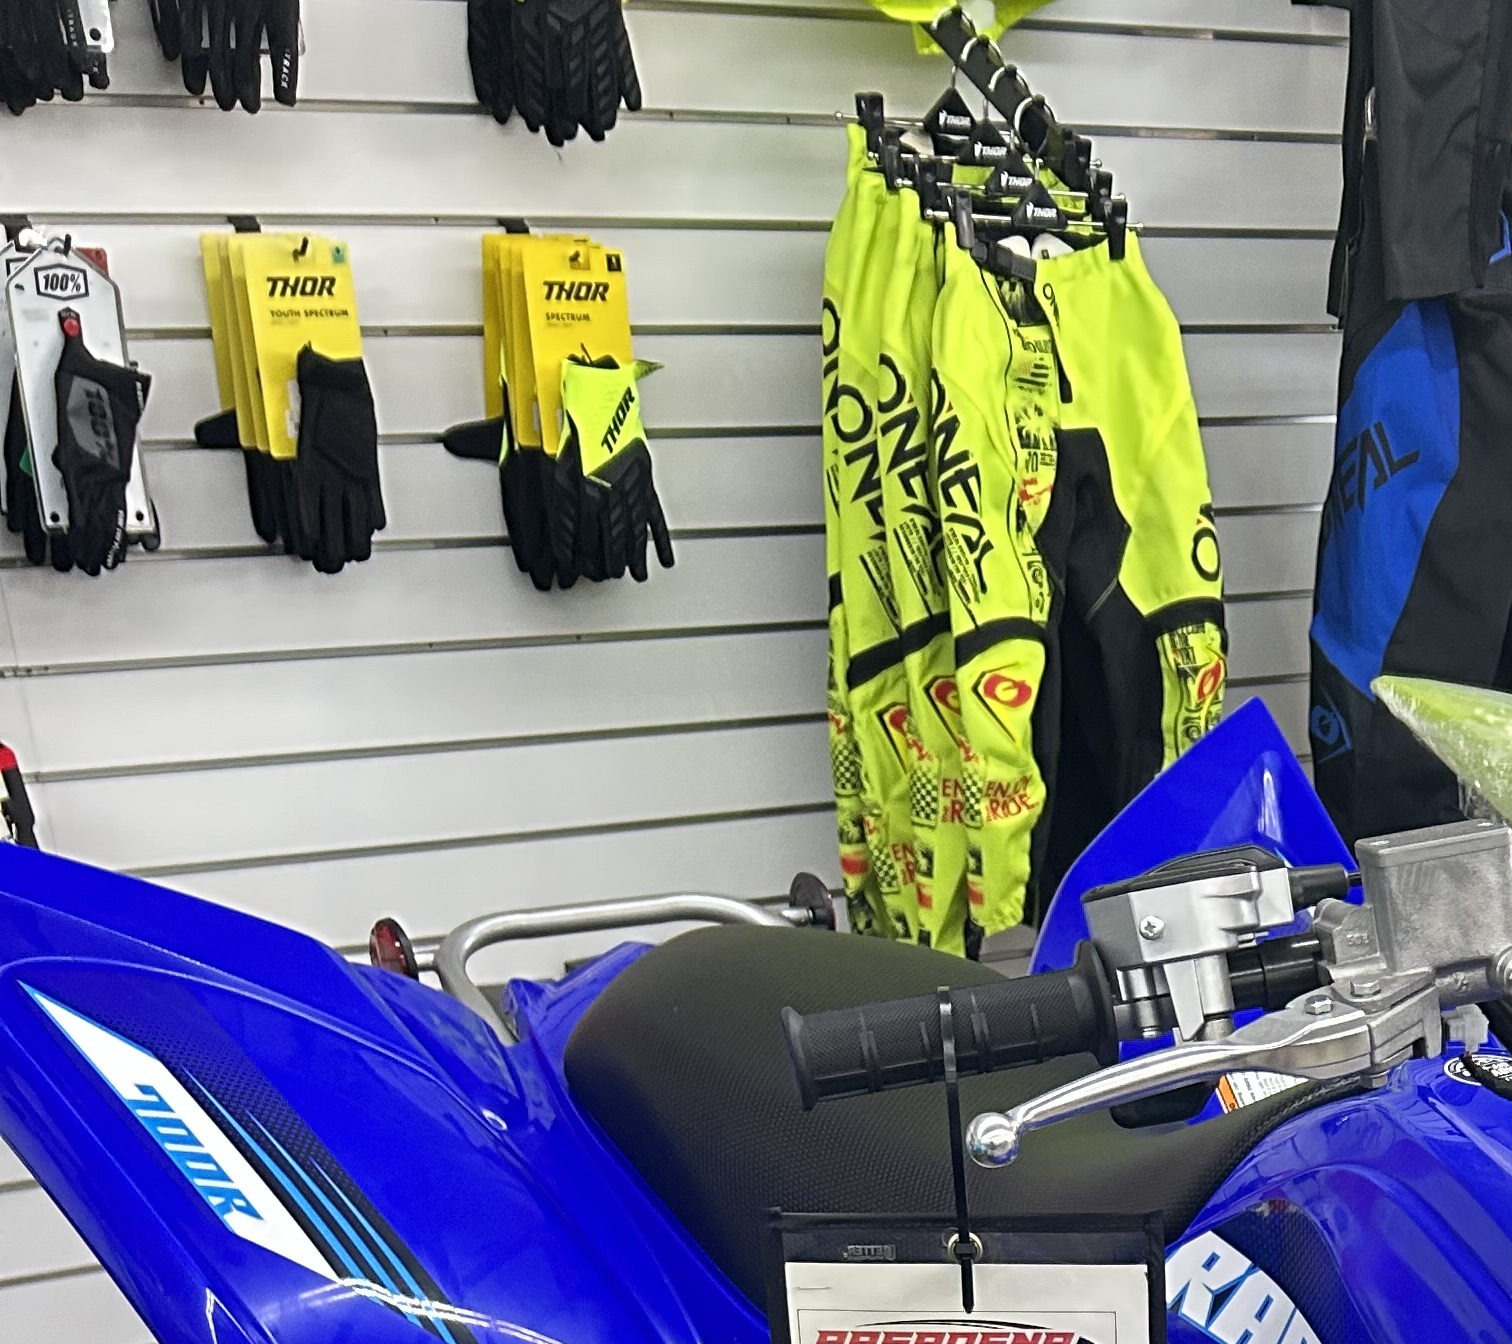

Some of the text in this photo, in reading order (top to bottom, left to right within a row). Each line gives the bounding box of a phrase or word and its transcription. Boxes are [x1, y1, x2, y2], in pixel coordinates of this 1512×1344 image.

[43, 273, 81, 292] 100%
[266, 275, 336, 297] THOR
[543, 280, 610, 302] THOR
[270, 309, 349, 318] YOUTH SPECTRUM
[545, 312, 591, 322] SPECTRUM
[600, 386, 636, 454] THOR
[125, 1083, 265, 1224] 700R
